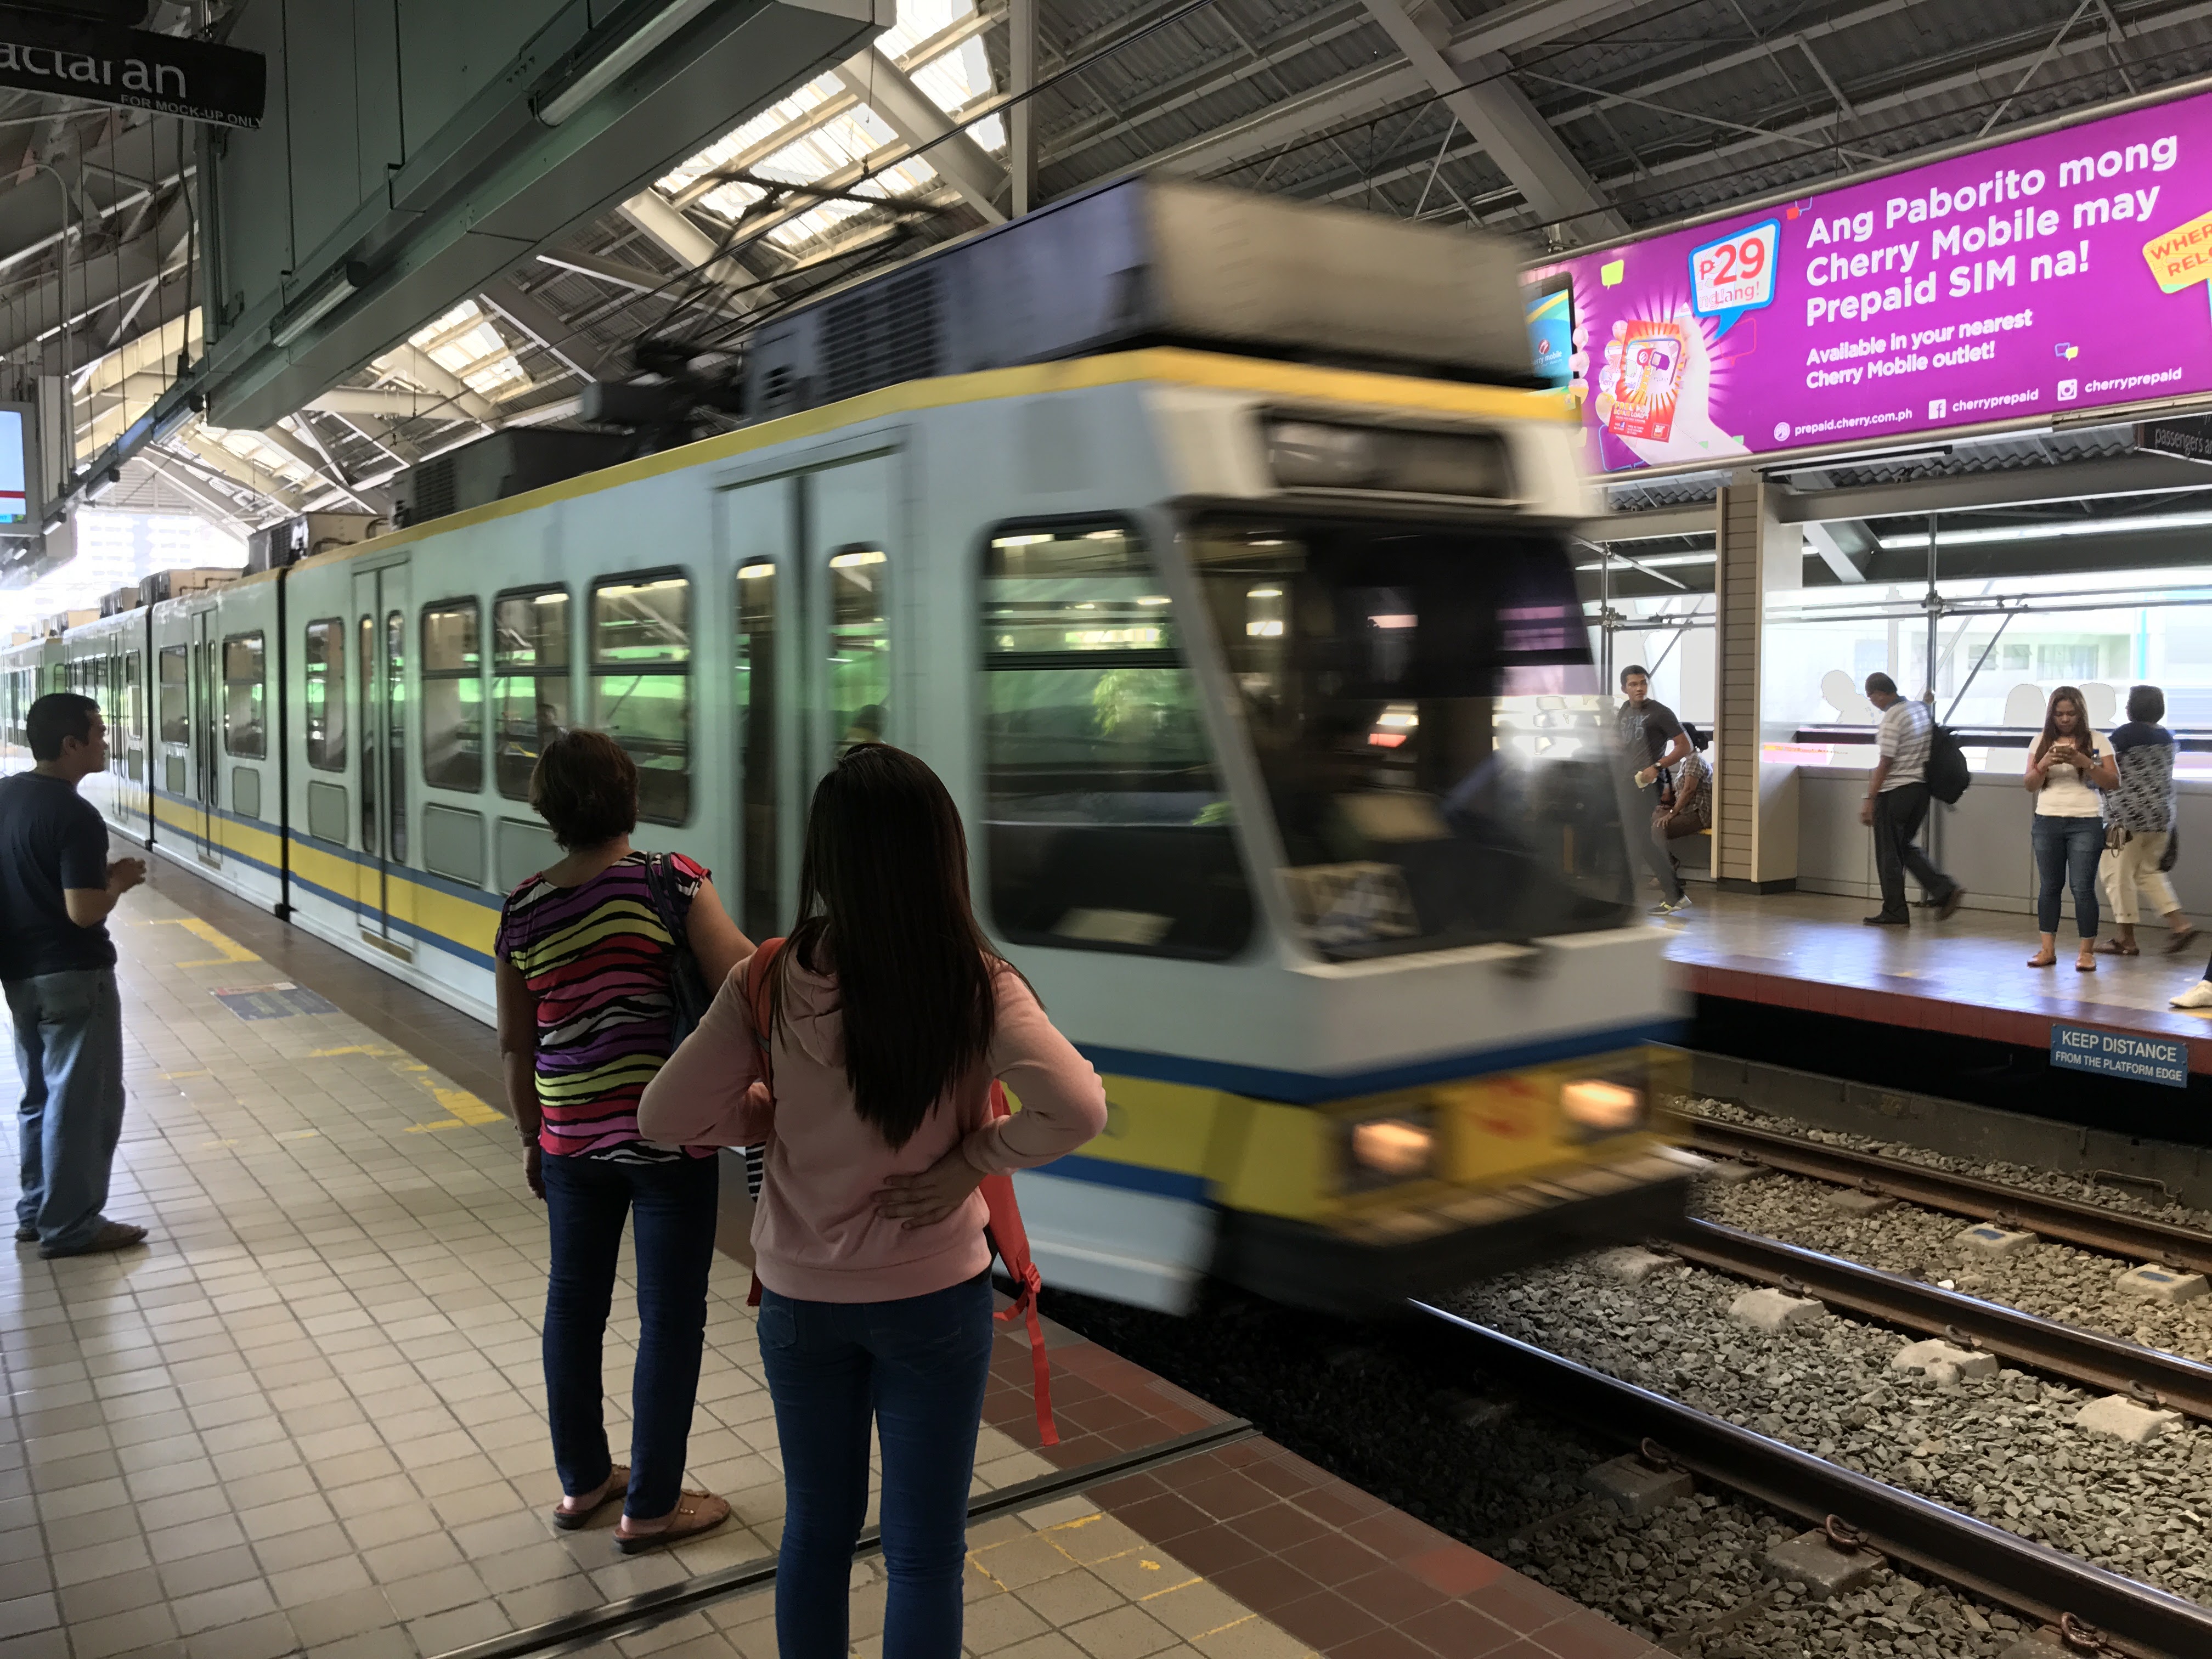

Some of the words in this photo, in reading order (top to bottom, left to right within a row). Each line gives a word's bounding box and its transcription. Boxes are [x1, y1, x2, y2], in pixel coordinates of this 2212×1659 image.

[121, 94, 151, 109] FOR
[156, 100, 223, 120] MOCK-UP
[227, 113, 263, 128] ONLY
[1806, 210, 1874, 249] Ang
[1886, 169, 2045, 229] Paborito
[2059, 135, 2177, 188] mong
[1806, 240, 1920, 286] Cherry
[1932, 206, 2059, 260] Mobile
[2073, 185, 2160, 229] may
[2167, 246, 2212, 277] REL
[1807, 270, 1936, 327] Prepaid
[1949, 255, 2016, 297] SIM
[2030, 239, 2089, 282] na!
[1806, 336, 1887, 366] Available
[1891, 332, 1907, 351] in
[1911, 325, 1955, 351] your
[1959, 308, 2033, 339] nearest
[1545, 350, 1562, 361] mobile
[1806, 366, 1864, 389] Cherry
[1867, 353, 1928, 379] Mobile
[1932, 340, 1995, 368] outlet!
[2084, 366, 2182, 393] cherryprepaid
[1952, 388, 2039, 412] cherryprepaid
[1795, 408, 1913, 437] prepaid.cherry.com.ph
[2062, 1030, 2099, 1048] KEEP
[2102, 1036, 2177, 1062] DISTANCE
[2055, 1051, 2081, 1065] FROM
[2084, 1055, 2101, 1068] THE
[2103, 1058, 2153, 1077] PLATFORM
[2155, 1067, 2182, 1081] EDGE
